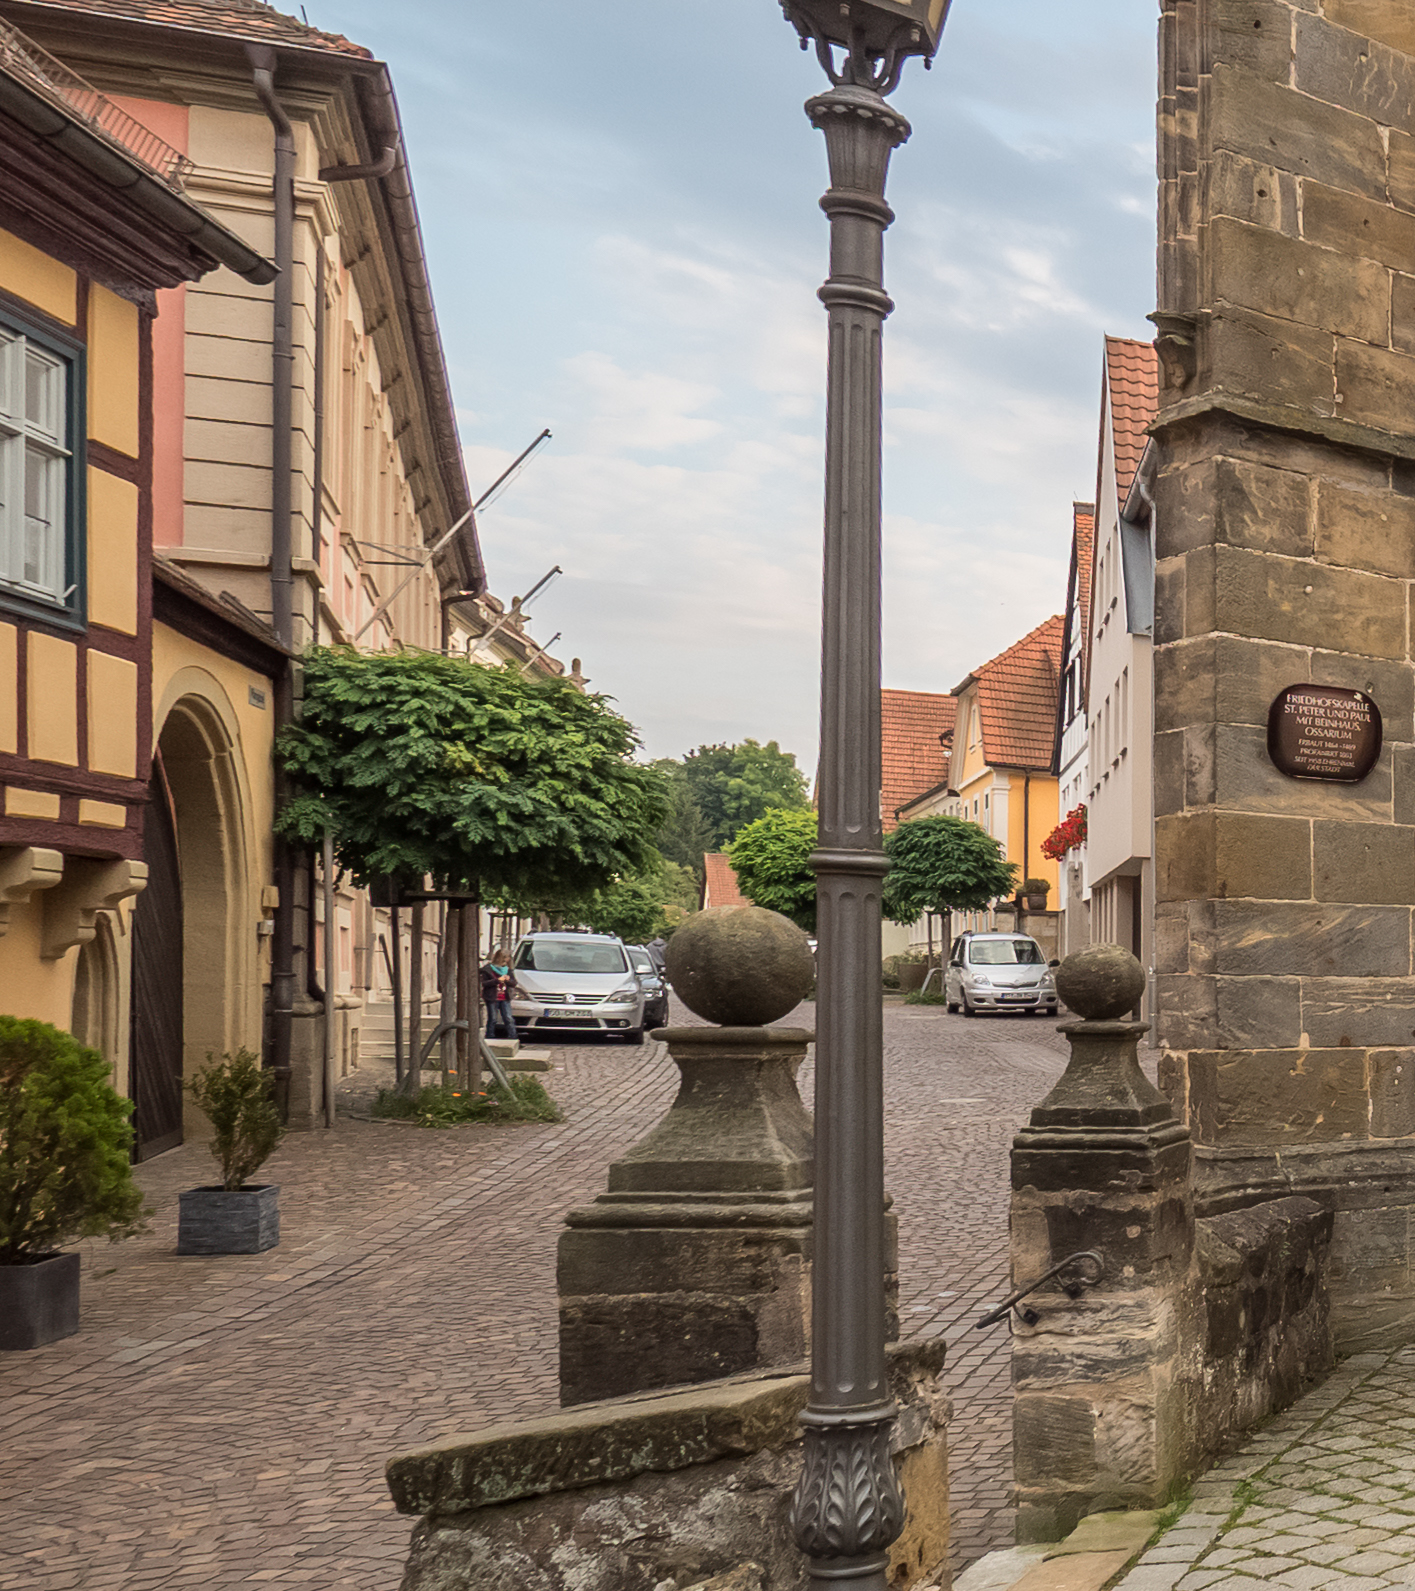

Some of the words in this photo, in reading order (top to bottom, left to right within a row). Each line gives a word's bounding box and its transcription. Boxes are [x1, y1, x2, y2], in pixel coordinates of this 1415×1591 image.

[1286, 693, 1370, 712] FRIEDHOFSKAPELLE
[1284, 703, 1298, 714] ST.
[1299, 705, 1325, 717] PETER
[1327, 708, 1349, 719] UND
[1350, 711, 1371, 723] PAUL
[1295, 716, 1313, 725] MIT
[1305, 726, 1352, 740] OSSARIUM
[1298, 738, 1323, 747] ERBAUT
